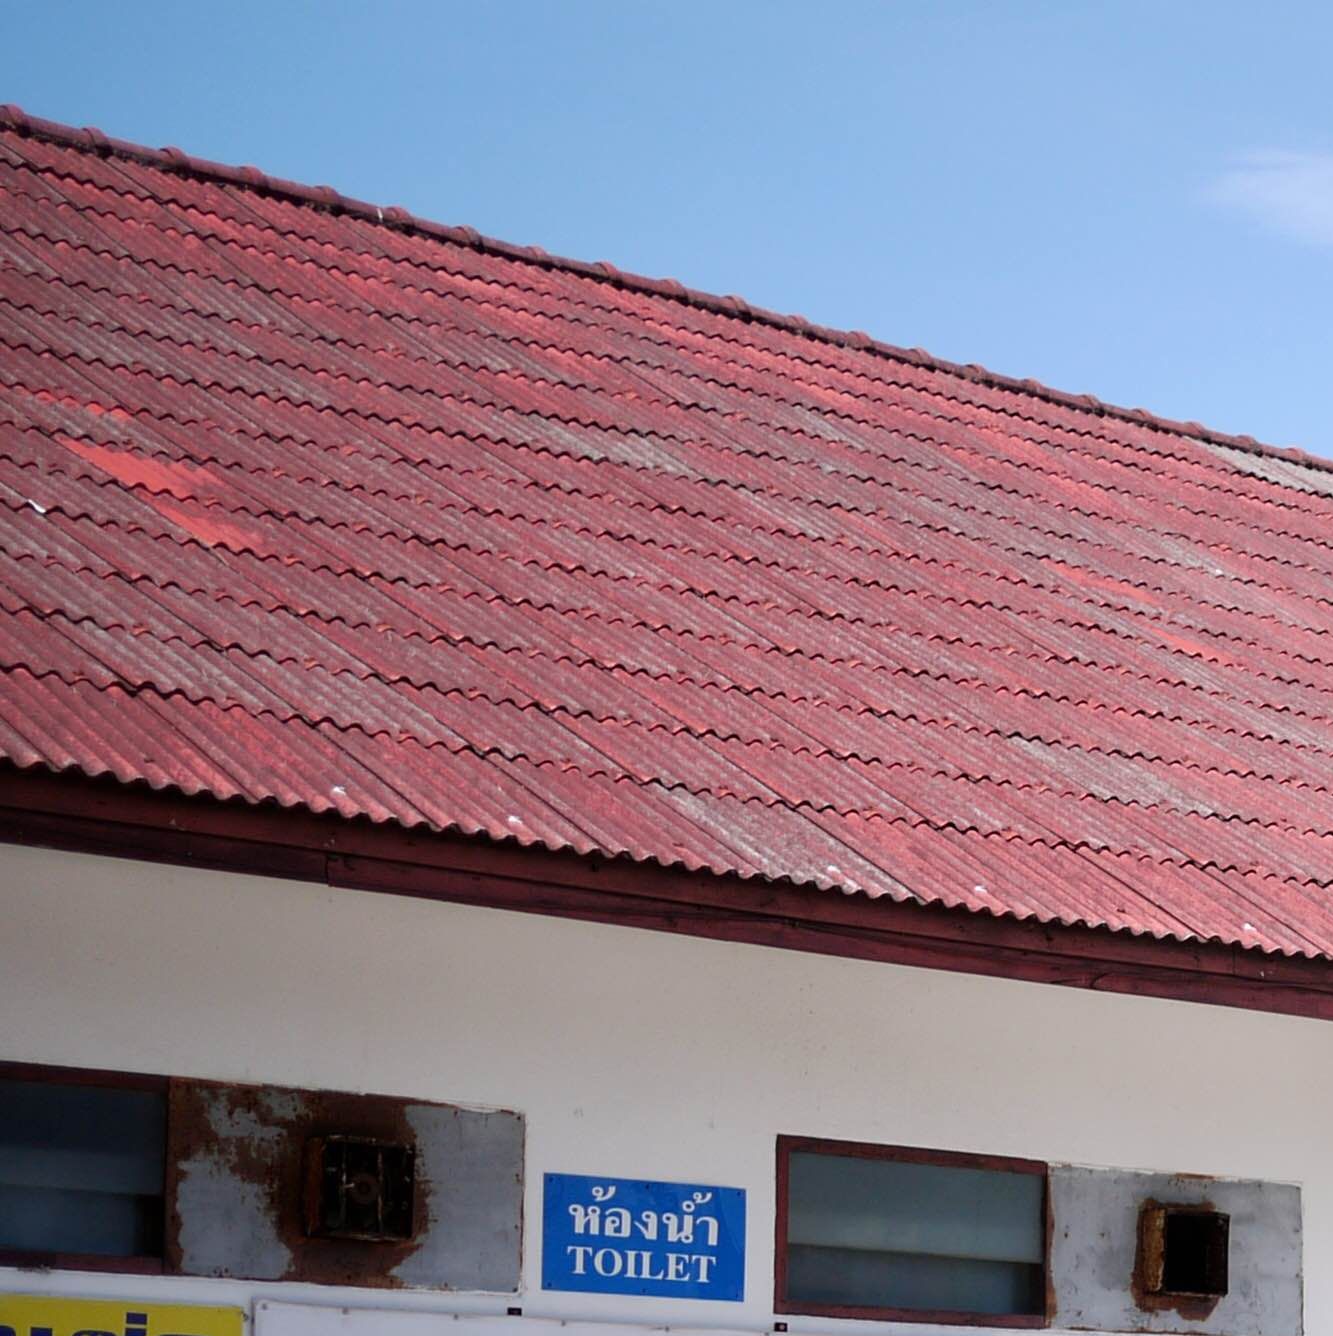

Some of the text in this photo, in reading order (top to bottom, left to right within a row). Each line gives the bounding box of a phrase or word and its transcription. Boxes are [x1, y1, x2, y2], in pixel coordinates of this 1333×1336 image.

[568, 1185, 719, 1246] ห้องน้ำ
[567, 1246, 717, 1283] TOILET
